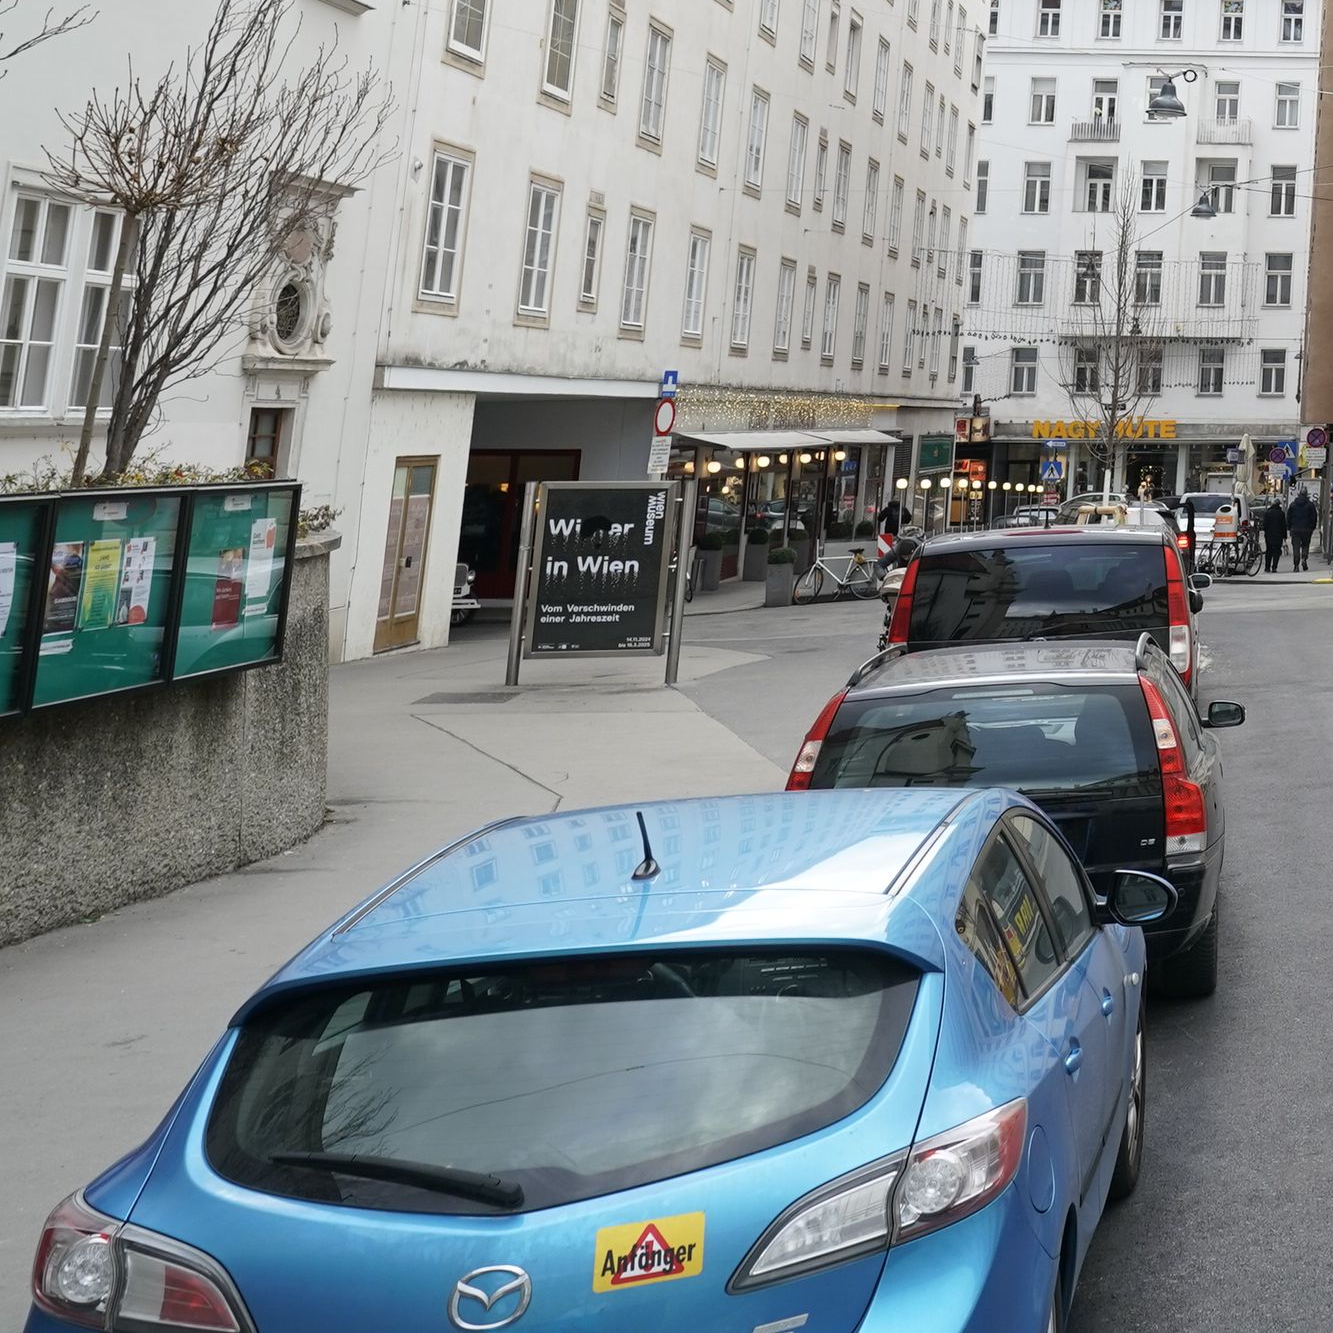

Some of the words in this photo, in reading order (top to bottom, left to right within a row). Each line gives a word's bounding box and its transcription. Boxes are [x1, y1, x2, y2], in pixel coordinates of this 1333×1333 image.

[1032, 419, 1101, 438] NAGY
[548, 518, 635, 539] Wier
[545, 556, 568, 578] in
[577, 556, 640, 577] Wien
[541, 604, 563, 613] Vom
[567, 603, 635, 613] Verschwinden
[540, 615, 565, 623] einer
[569, 614, 620, 623] Jahreszeit
[601, 1242, 697, 1278] Anfänger
